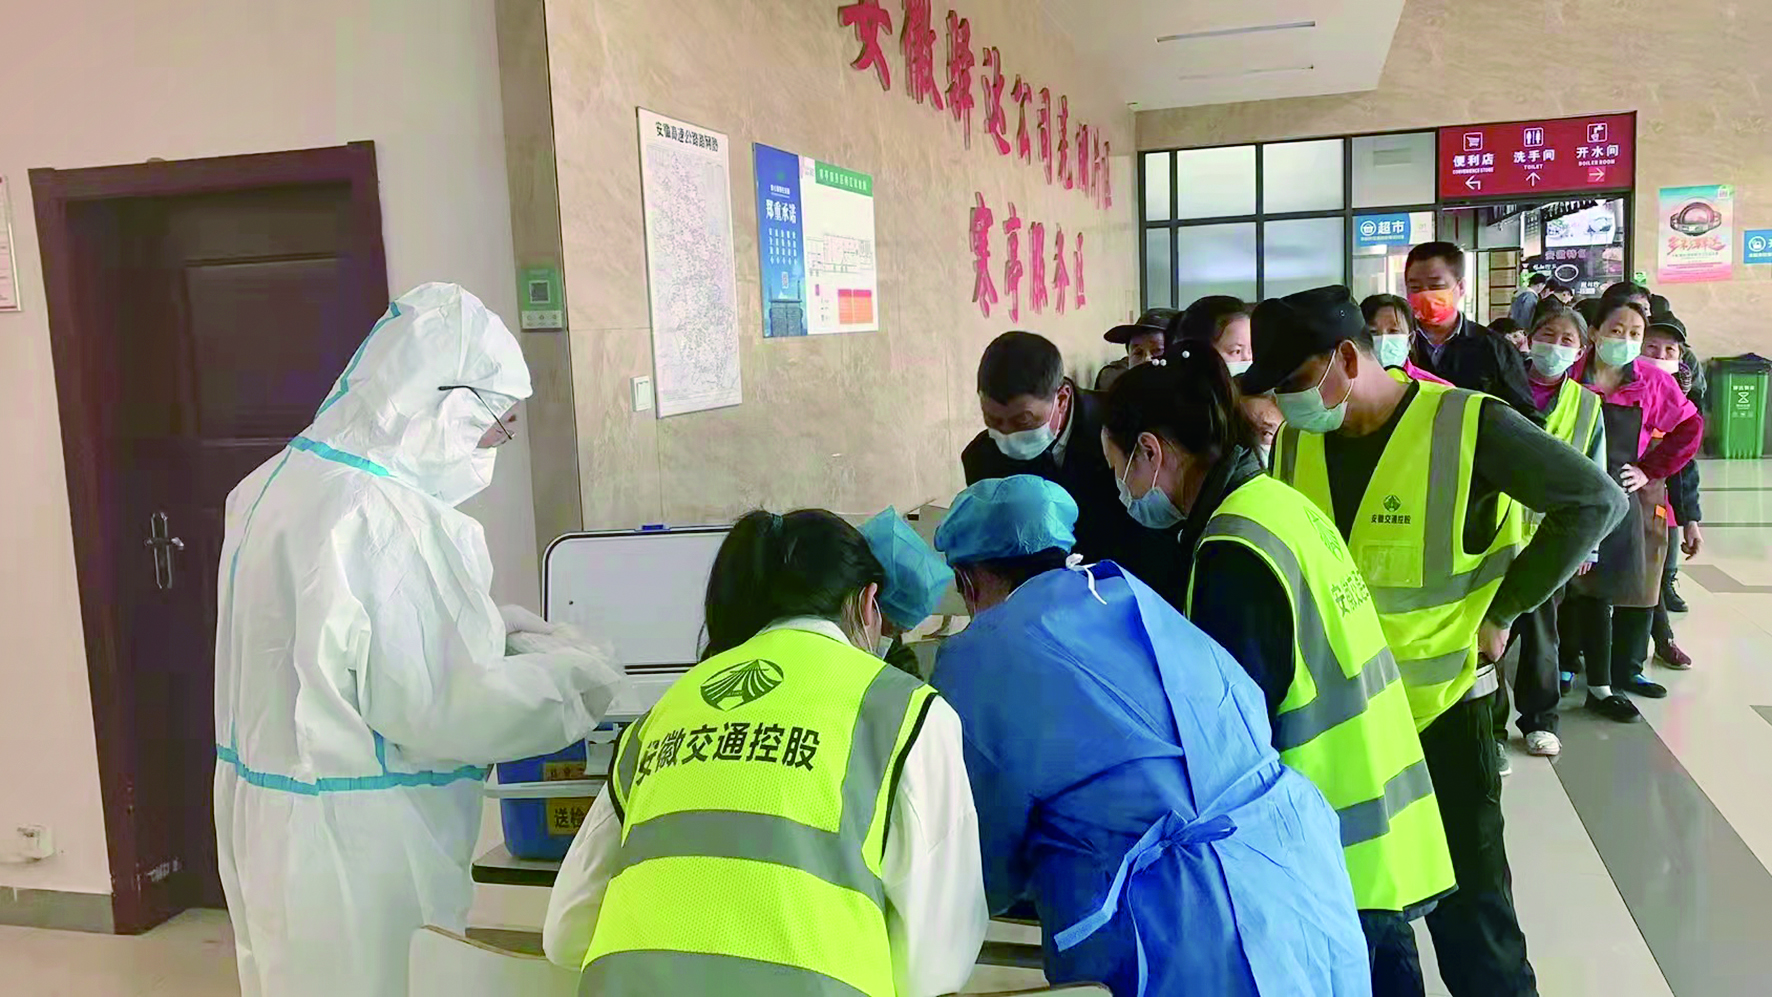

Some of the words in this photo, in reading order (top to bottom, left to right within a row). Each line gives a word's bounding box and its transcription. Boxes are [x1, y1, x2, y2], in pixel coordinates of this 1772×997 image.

[1513, 149, 1555, 164] 洗手间
[1576, 144, 1619, 160] 开水间
[1453, 153, 1494, 168] 便利店
[765, 198, 797, 224] 郑重承诺
[1377, 220, 1405, 235] 超市
[970, 191, 1086, 324] 寒亭服务区
[1371, 514, 1411, 525] 安徽交通控股
[636, 722, 820, 784] 安徽交通控股
